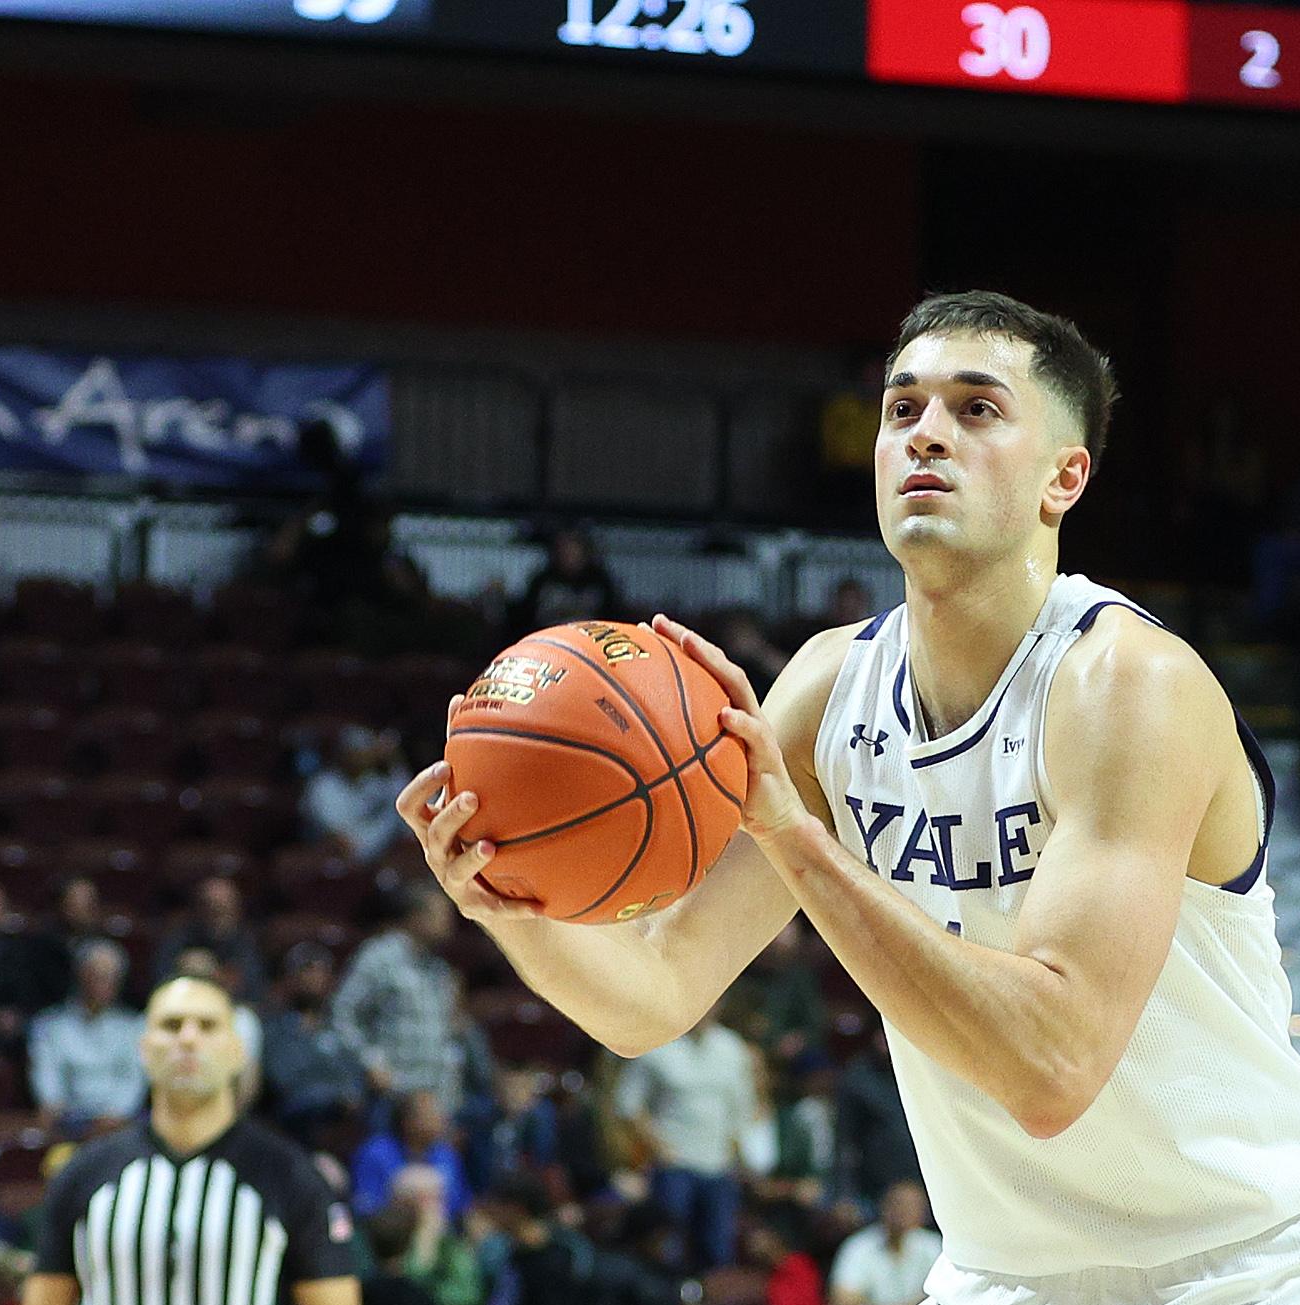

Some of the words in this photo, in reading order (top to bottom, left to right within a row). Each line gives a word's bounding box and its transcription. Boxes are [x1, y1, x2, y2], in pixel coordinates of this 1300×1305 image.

[558, 0, 755, 57] 12:26
[959, 1, 1051, 80] 30
[1240, 30, 1281, 88] 2
[844, 794, 1042, 891] YALE
